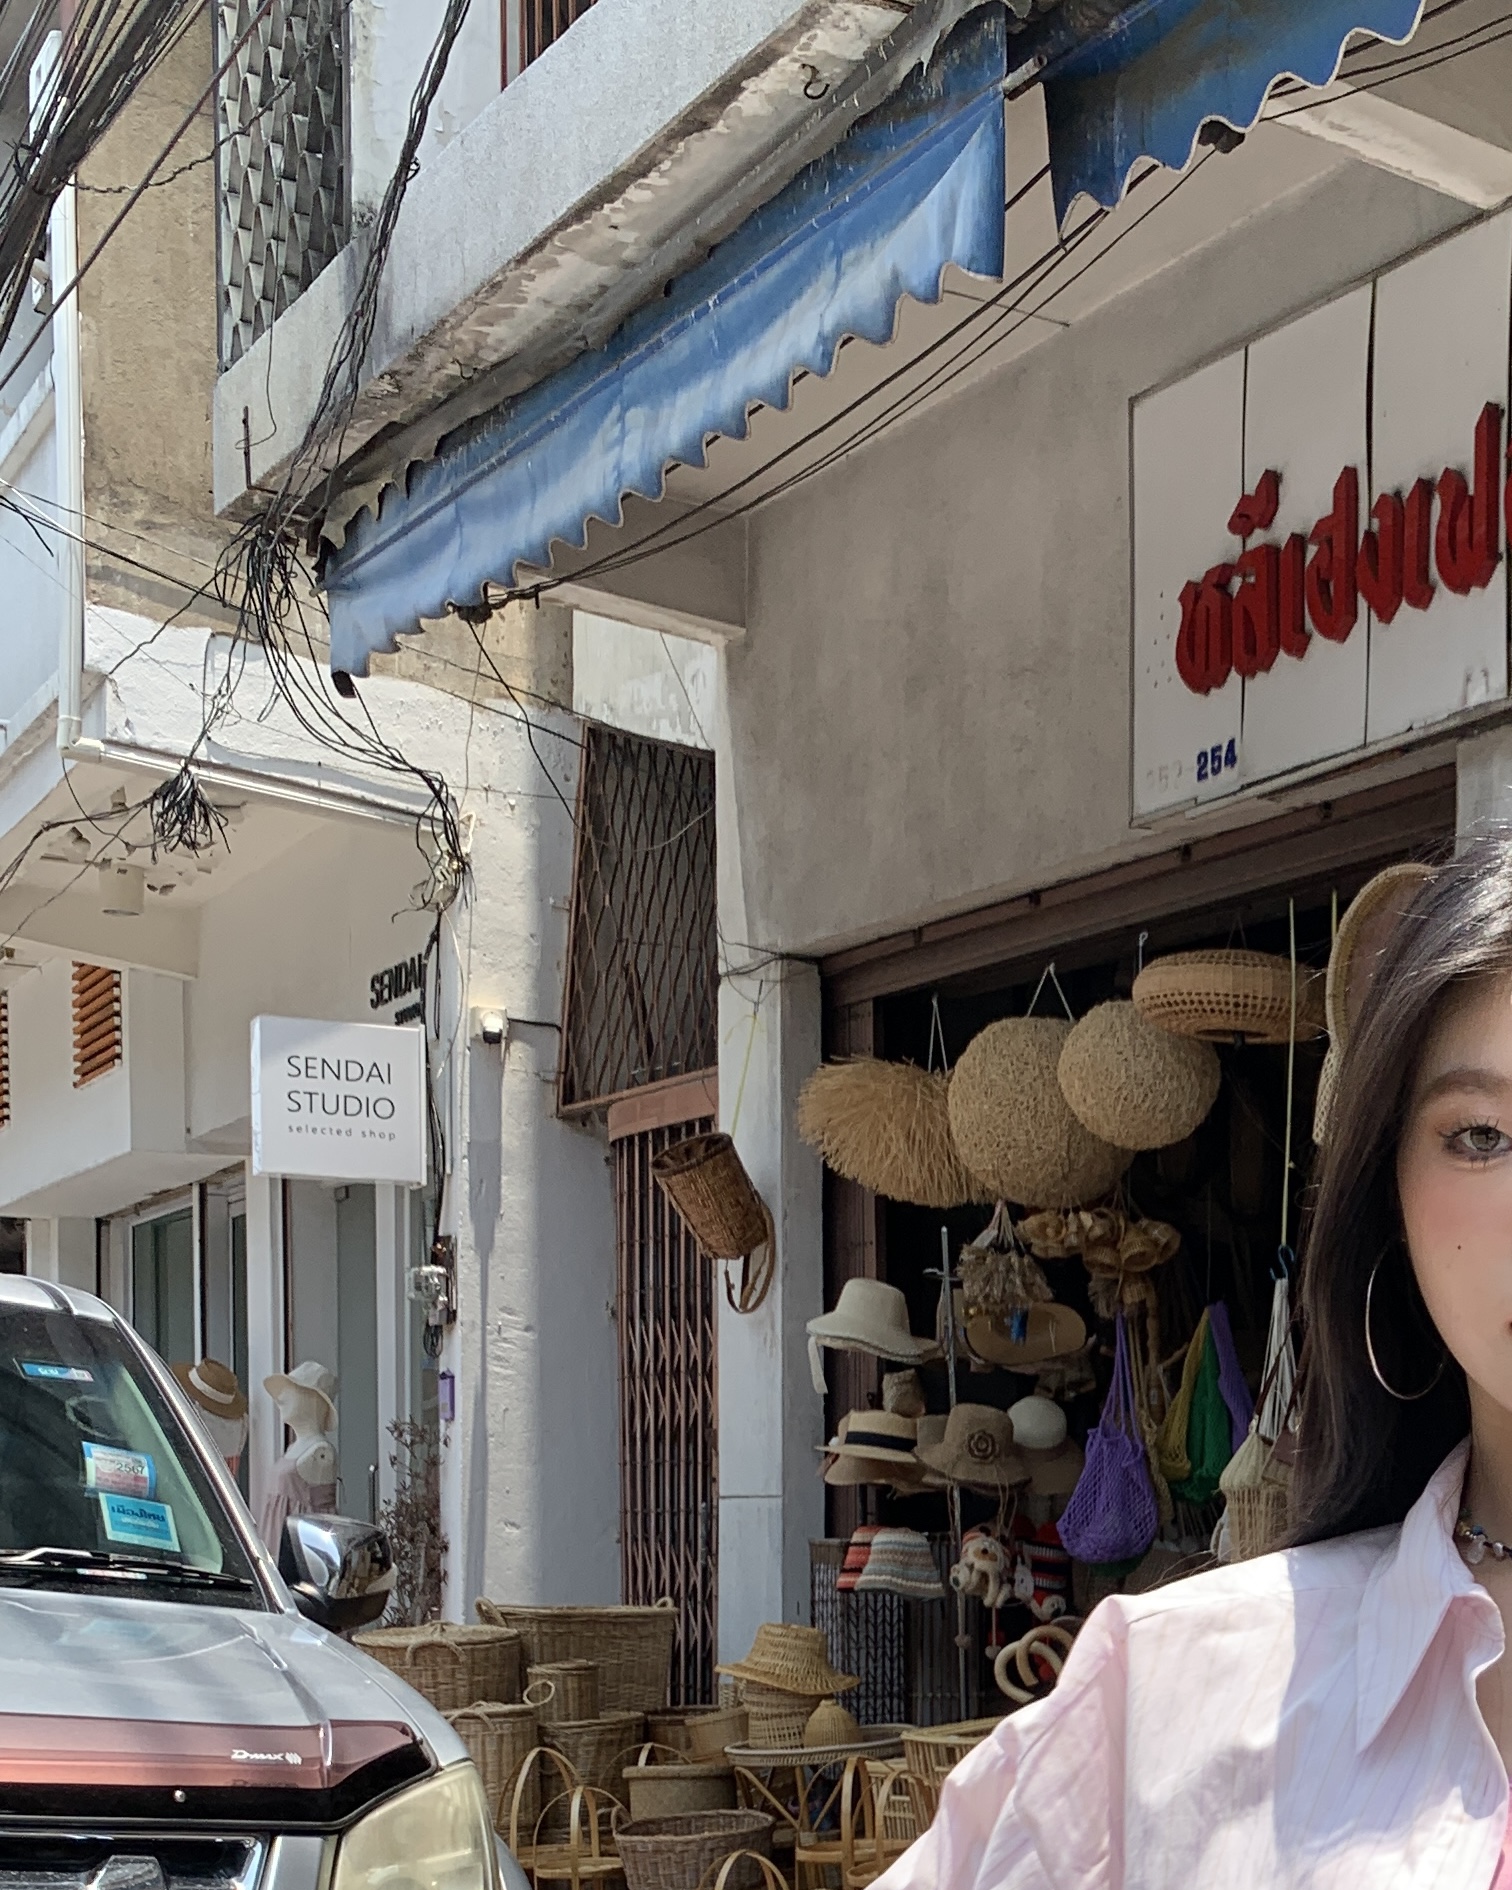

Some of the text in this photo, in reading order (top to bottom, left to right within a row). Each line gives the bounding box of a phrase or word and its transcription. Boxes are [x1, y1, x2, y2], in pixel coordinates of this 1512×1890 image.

[1196, 737, 1237, 782] 254
[286, 1055, 392, 1085] SENDAI
[286, 1090, 396, 1120] STUDIO
[288, 1124, 397, 1141] selected shop
